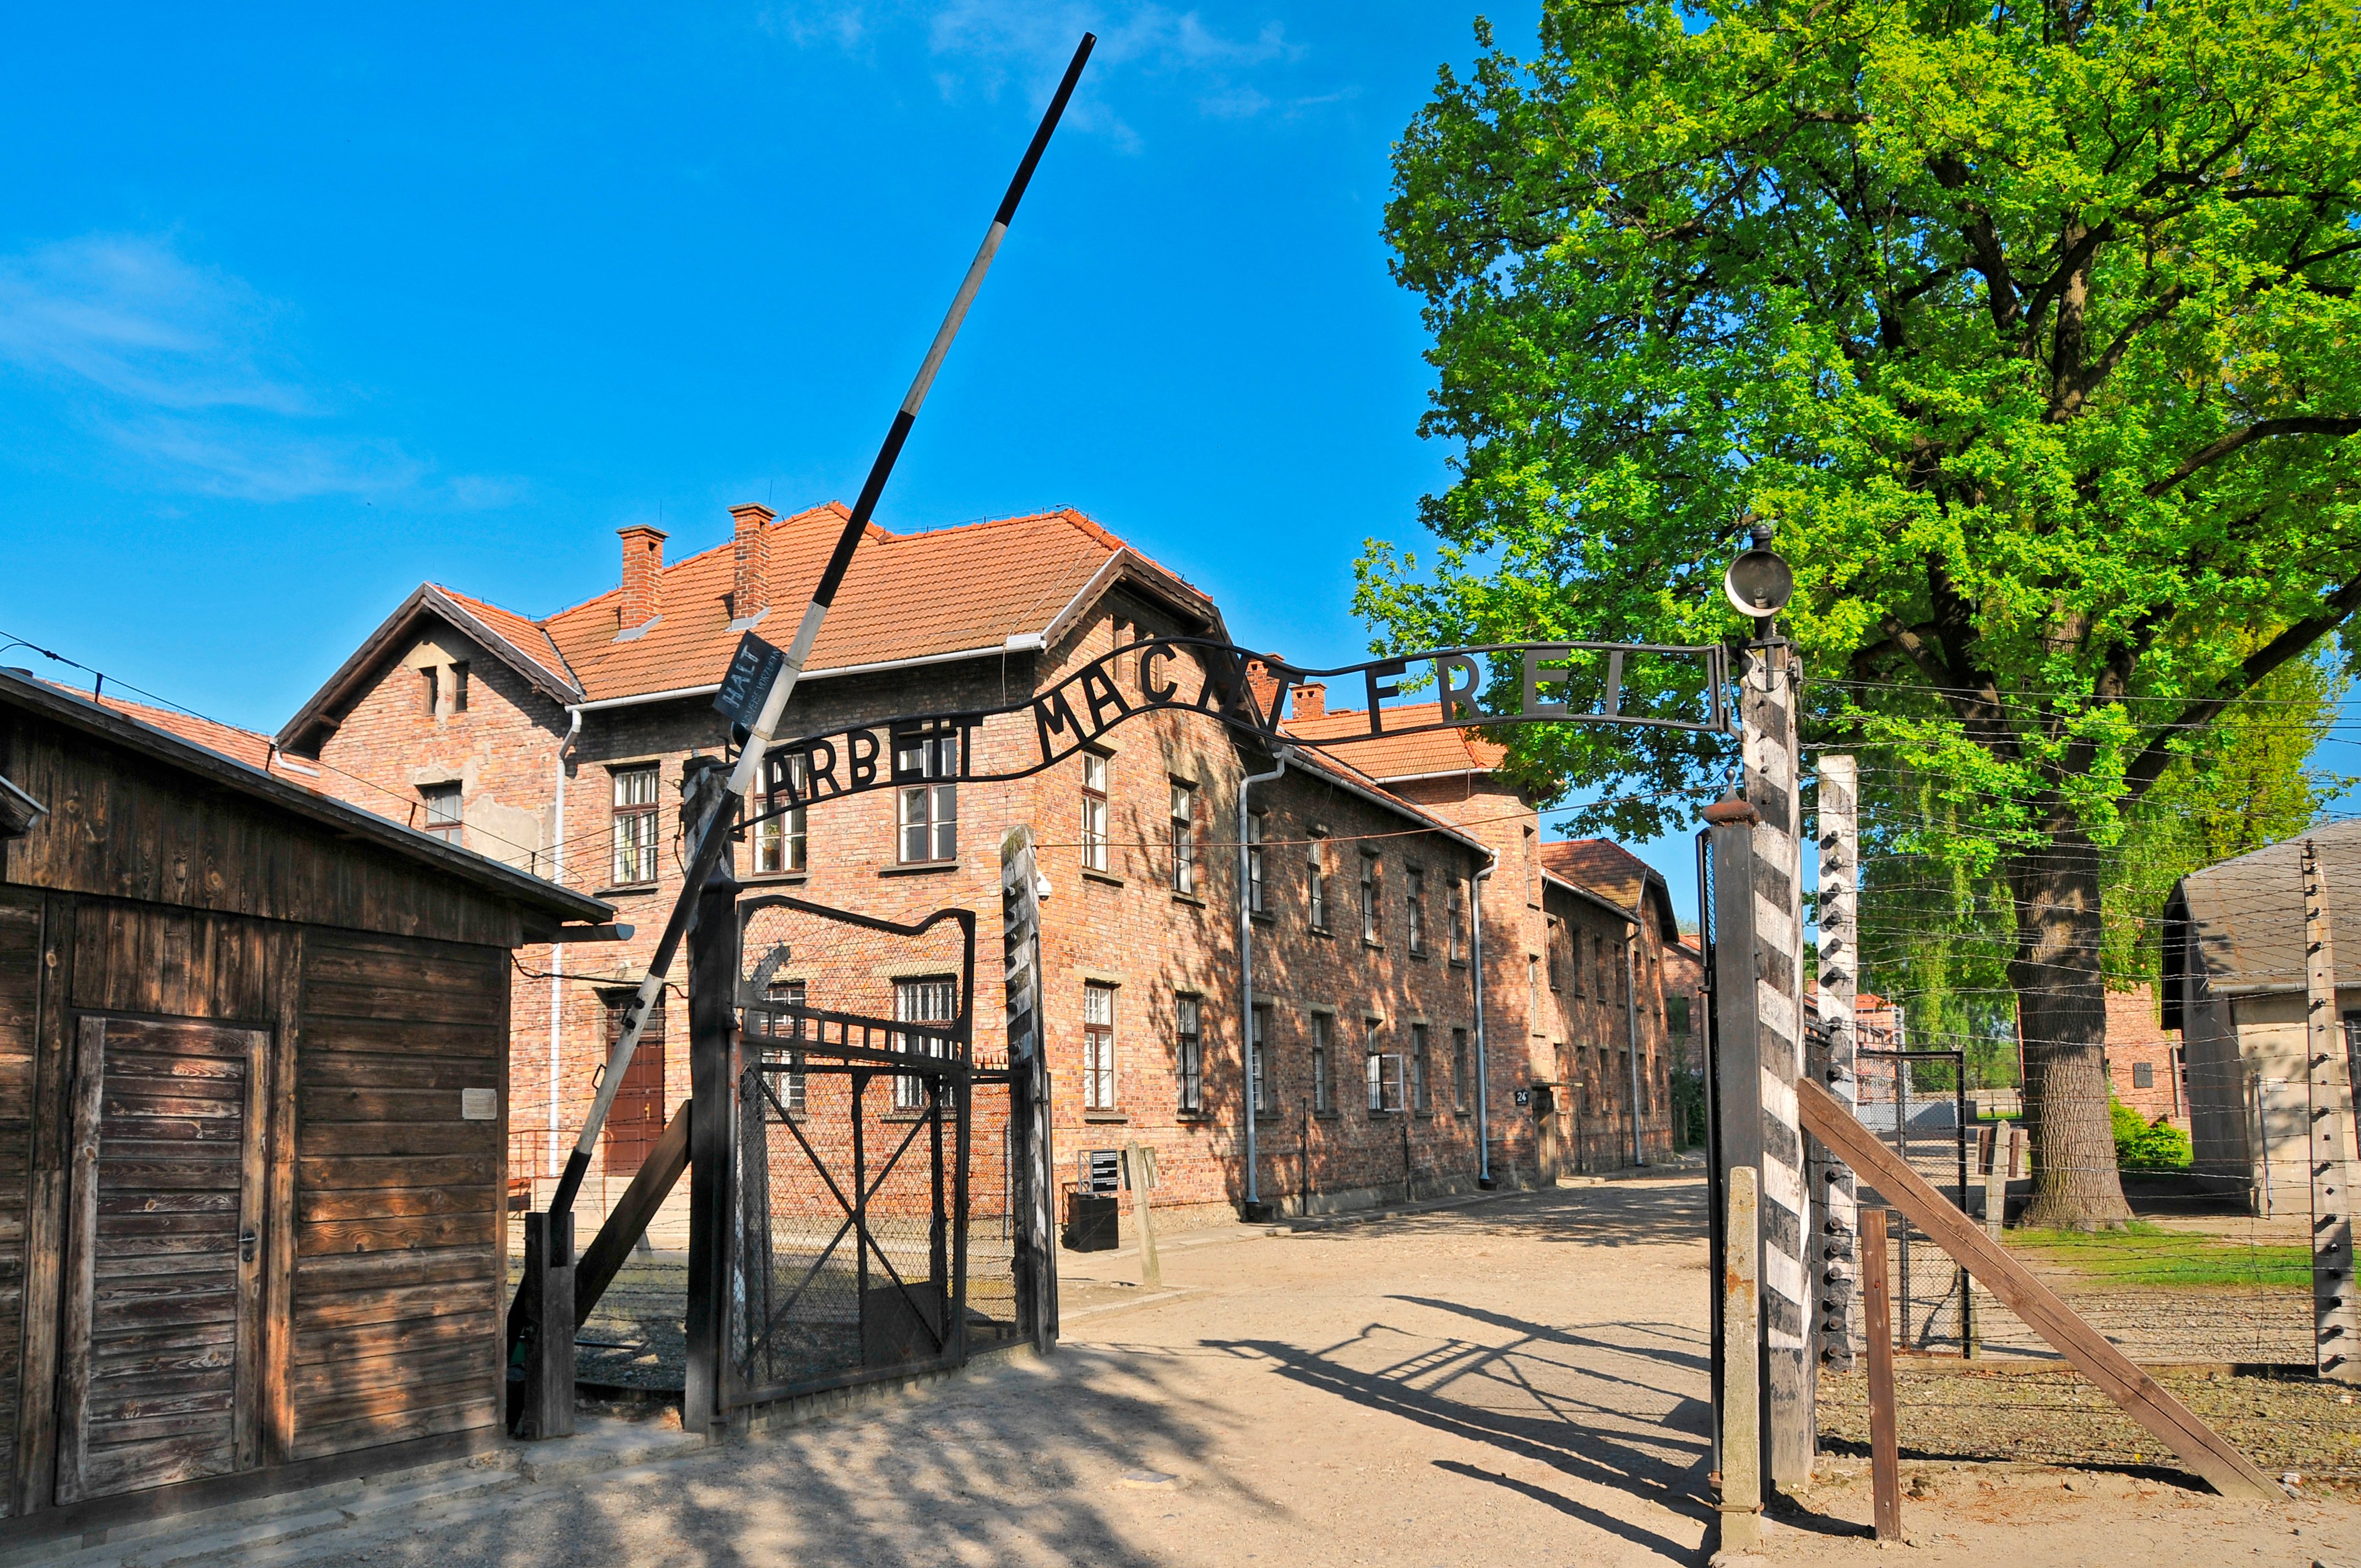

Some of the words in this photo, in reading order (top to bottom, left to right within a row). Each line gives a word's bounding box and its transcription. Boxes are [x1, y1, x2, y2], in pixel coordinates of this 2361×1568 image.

[722, 645, 760, 709] HALT
[768, 716, 983, 810] ARBEIT
[1033, 640, 1305, 762] MACHT
[1366, 650, 1624, 734] FREI
